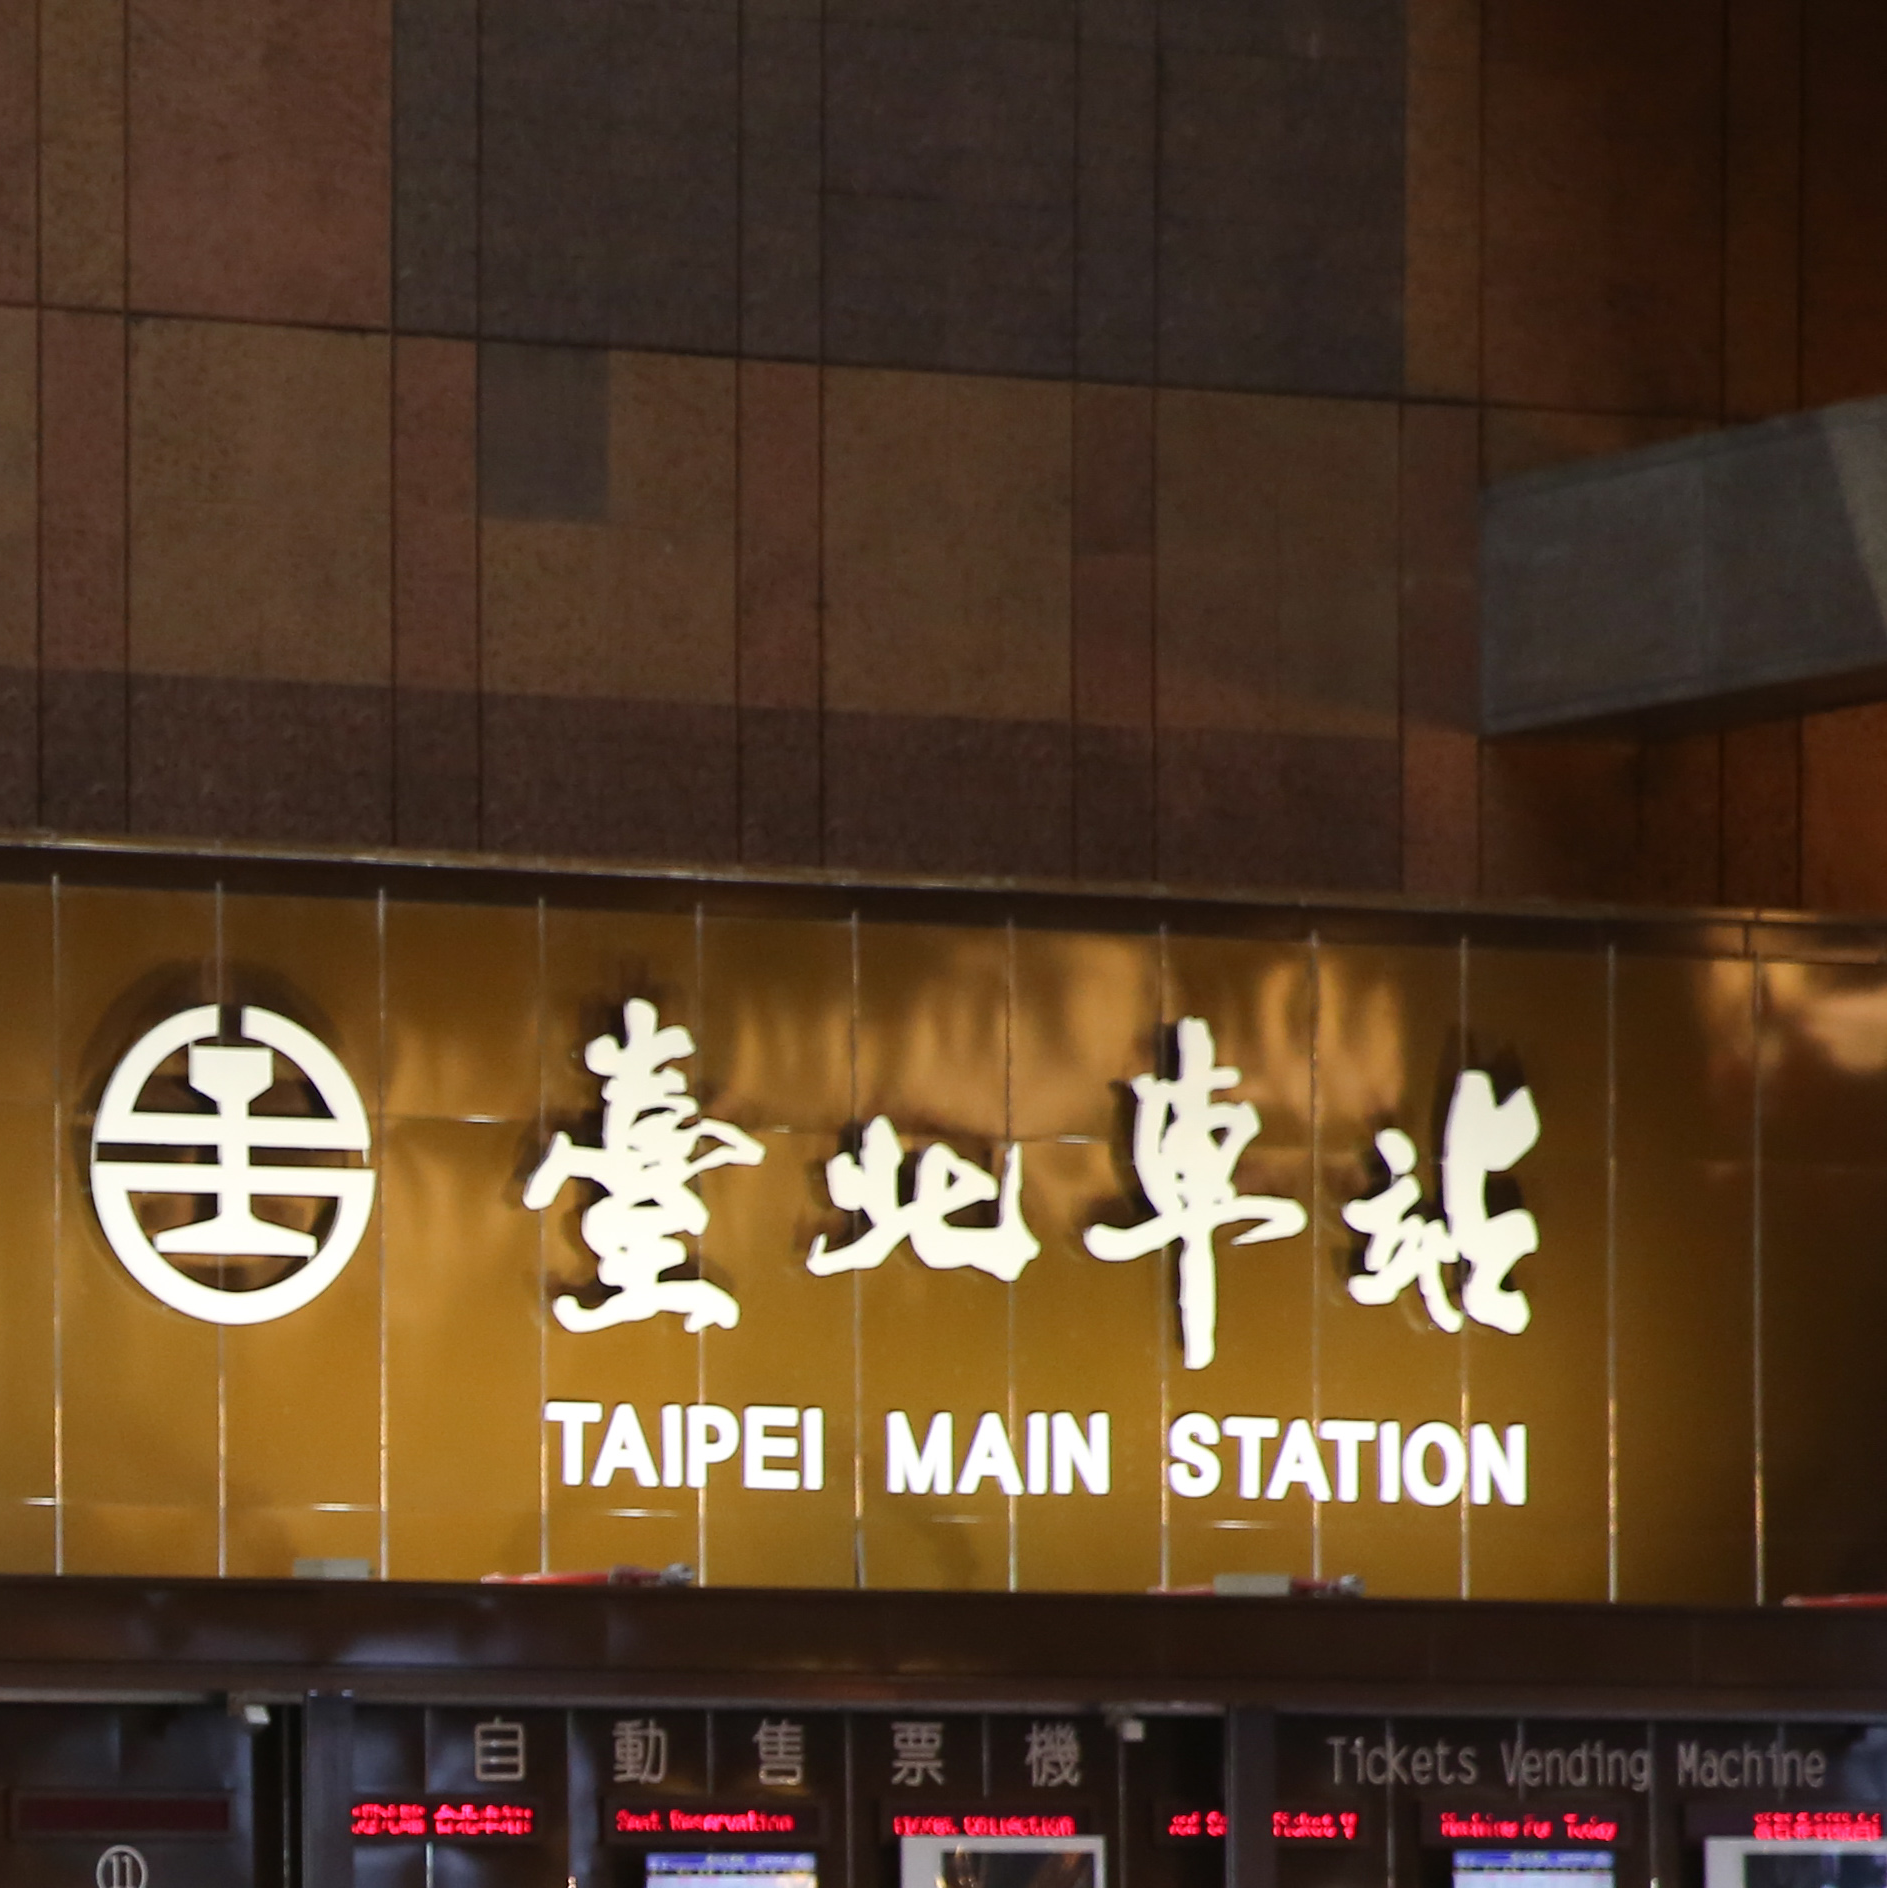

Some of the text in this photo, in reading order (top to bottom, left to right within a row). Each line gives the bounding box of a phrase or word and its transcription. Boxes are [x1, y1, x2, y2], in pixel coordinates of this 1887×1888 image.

[523, 999, 1542, 1370] 臺北車站
[542, 1400, 1529, 1507] TAIPEI MAIN STATION
[473, 1715, 1083, 1788] 自動售票機
[1326, 1735, 1826, 1792] Tickets Vending Machine
[669, 1808, 796, 1833] Reservation
